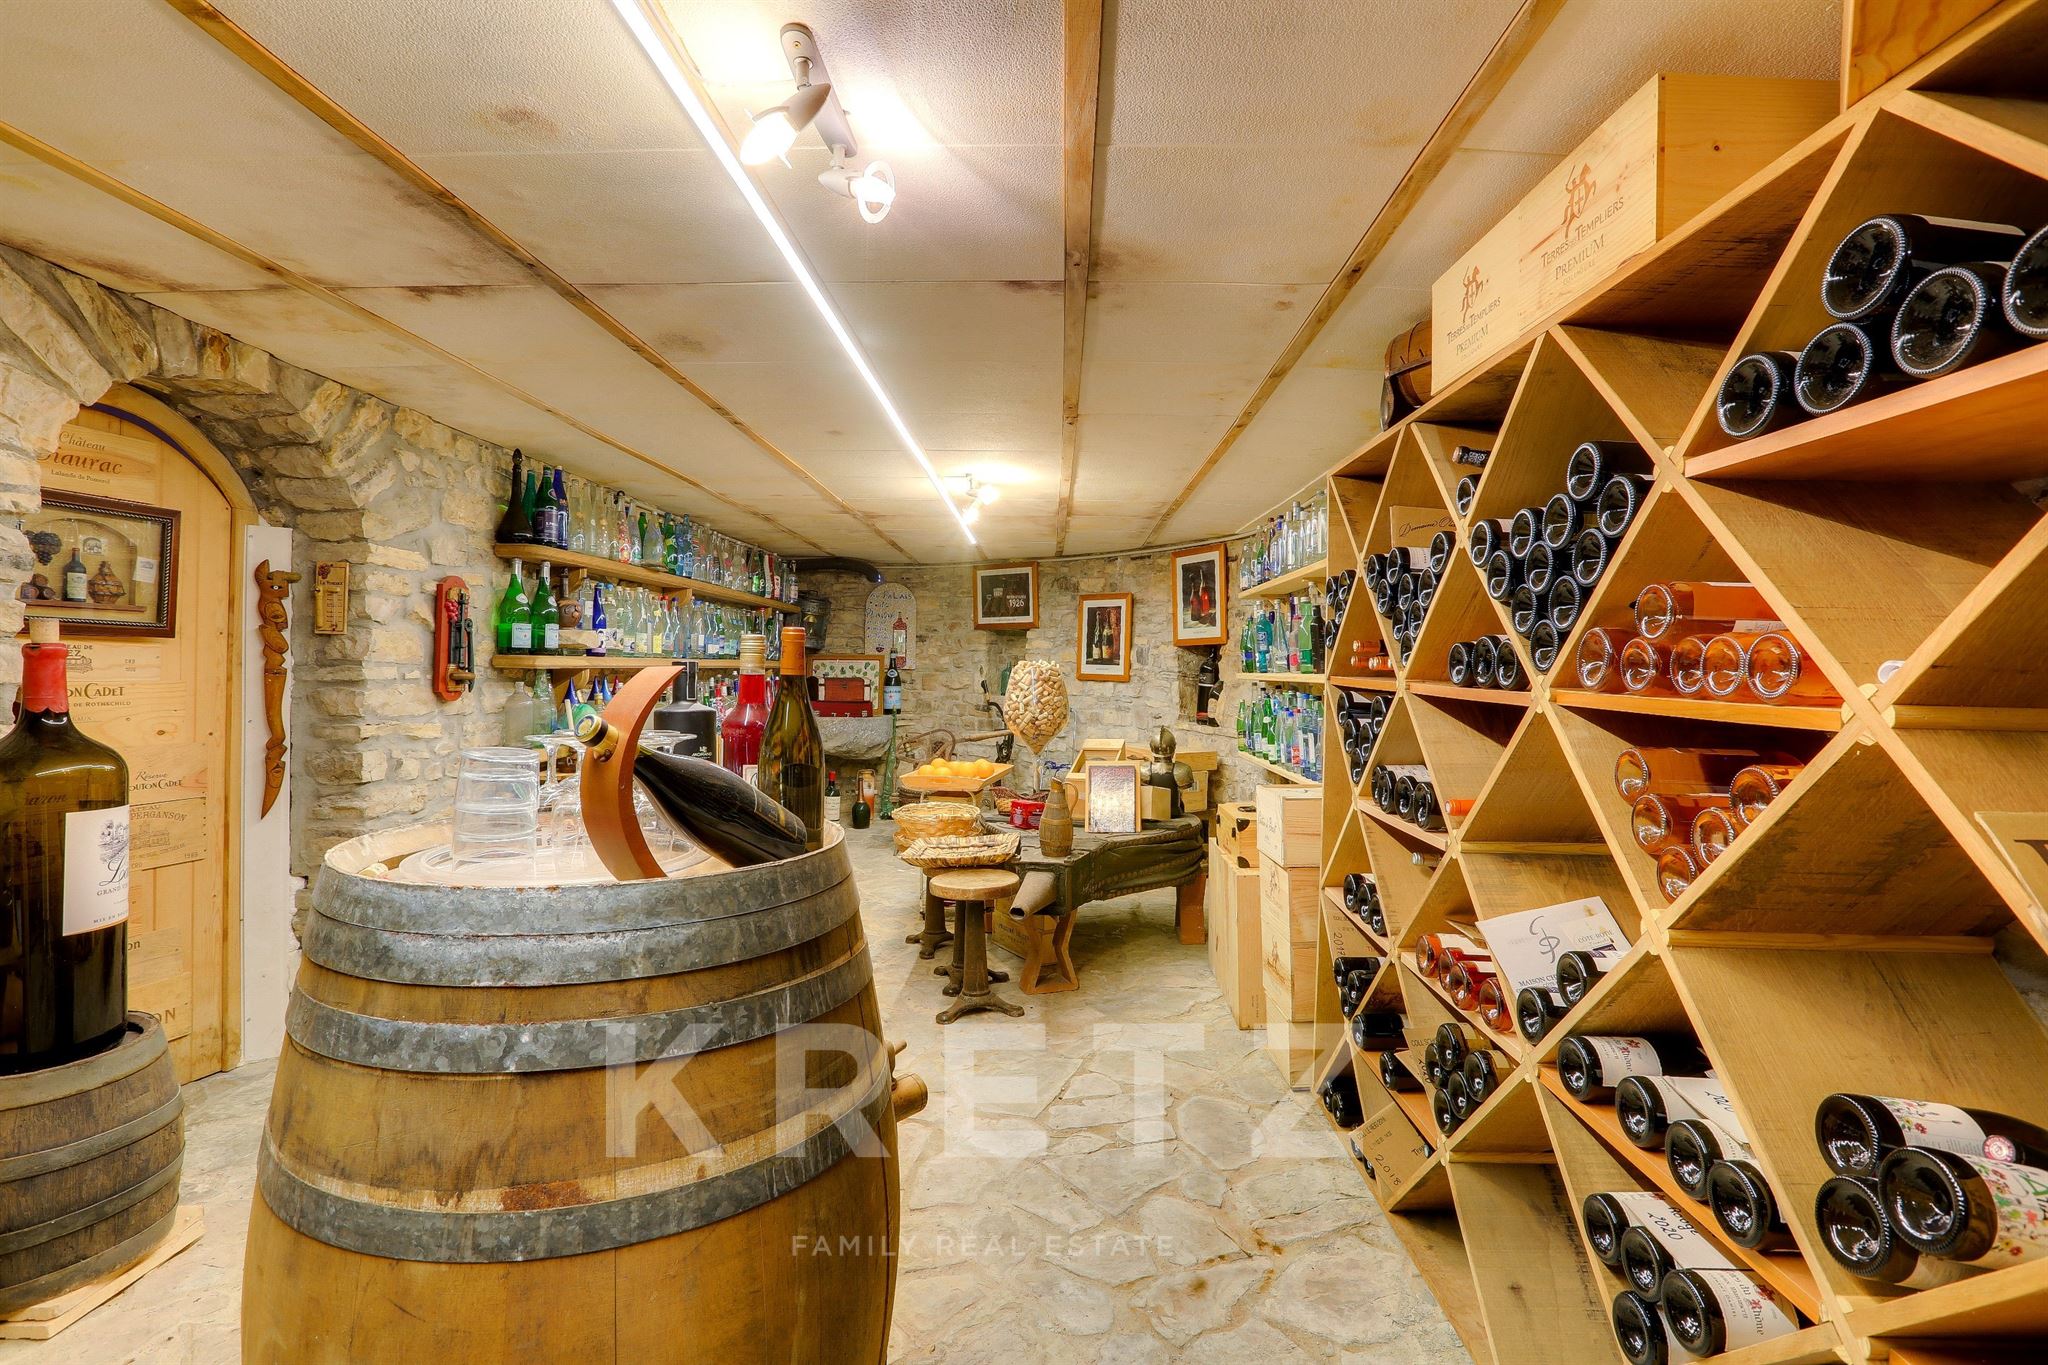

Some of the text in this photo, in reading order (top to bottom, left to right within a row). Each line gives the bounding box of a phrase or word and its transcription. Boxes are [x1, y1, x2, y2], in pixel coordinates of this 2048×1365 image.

[1541, 240, 1570, 268] TERRES
[1575, 197, 1624, 241] TEMPLIERS
[1555, 233, 1605, 280] PREMIUM
[1468, 296, 1501, 328] TEMPLIERS
[1456, 323, 1488, 356] PREMIUM
[58, 431, 105, 452] Château
[37, 446, 123, 475] iaurac
[1009, 599, 1025, 607] 1926
[84, 682, 125, 699] CADET
[97, 883, 121, 896] GRAND
[1518, 976, 1546, 987] MAISON
[1375, 1153, 1402, 1186] 2018
[1647, 1210, 1684, 1241] 2020
[1749, 1298, 1764, 1336] Rhône
